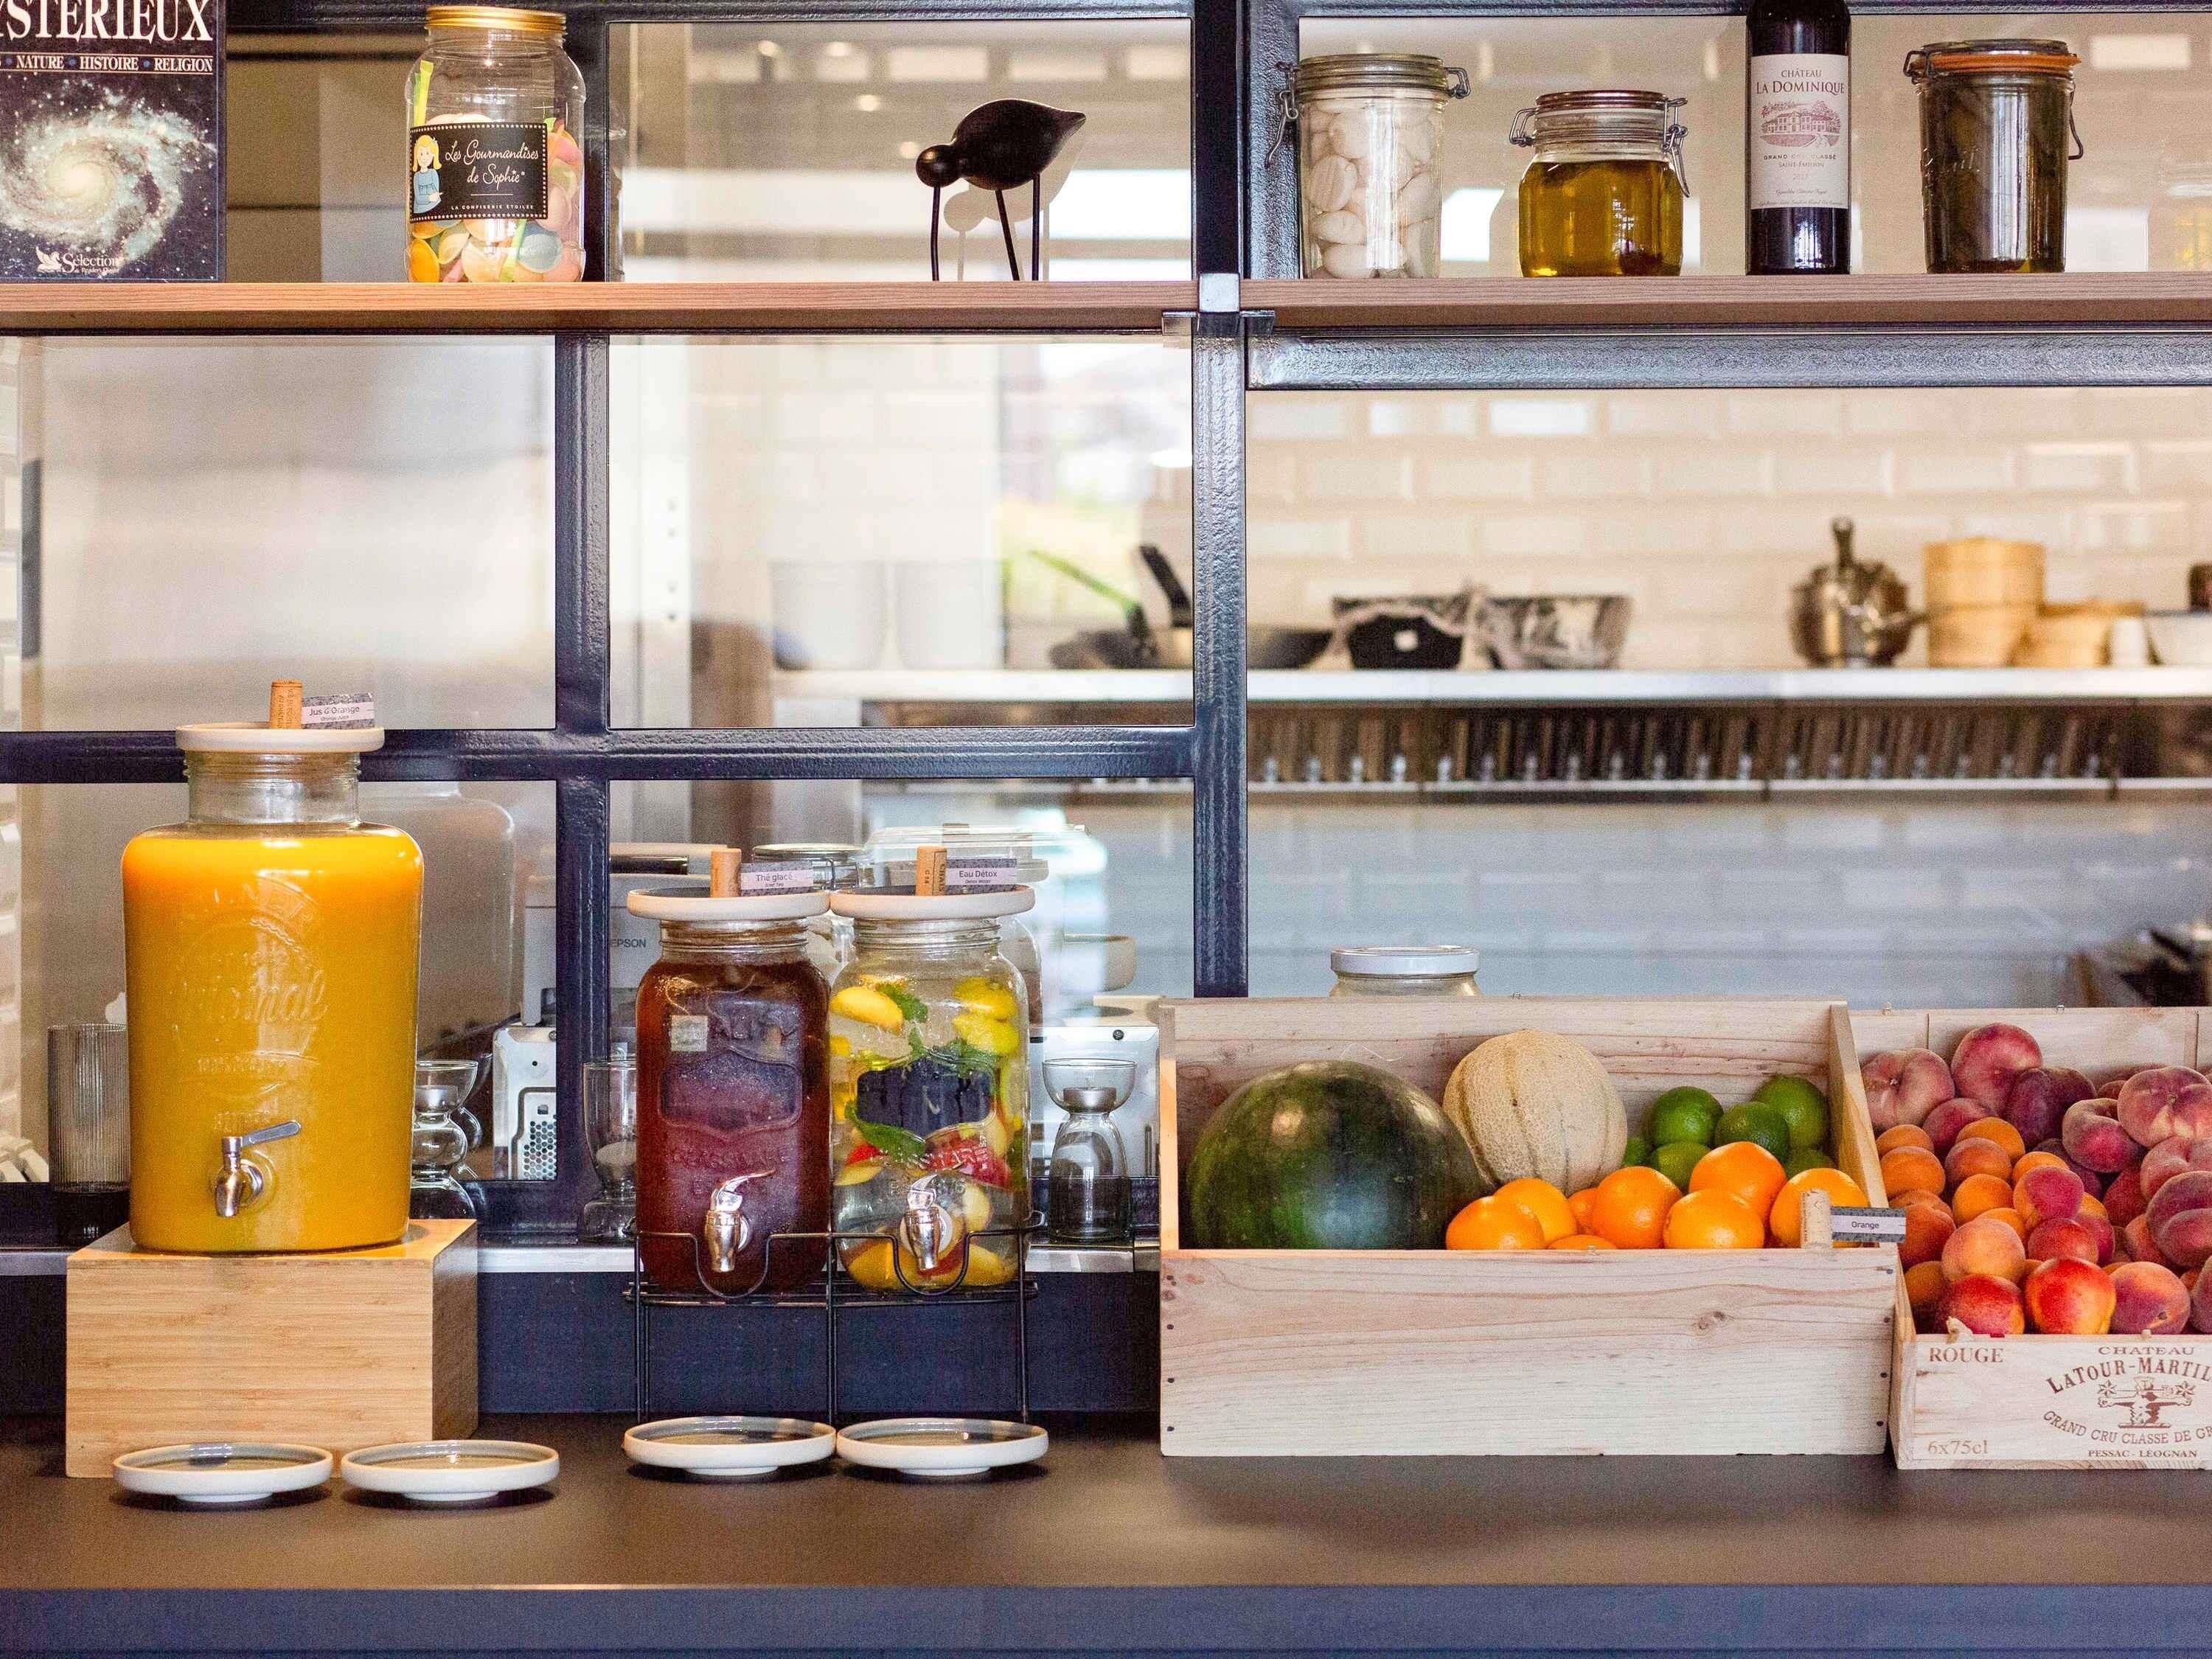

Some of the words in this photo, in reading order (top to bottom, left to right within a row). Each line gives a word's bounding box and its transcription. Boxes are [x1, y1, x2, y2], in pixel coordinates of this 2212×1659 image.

[0, 0, 213, 44] STERIEUX
[16, 55, 64, 69] NATURE
[80, 56, 139, 72] HISTOIRE
[153, 58, 213, 72] RELIGION
[1781, 68, 1821, 78] CHÂTEAU
[1756, 82, 1769, 94] LA
[1772, 80, 1845, 96] DOMINIQUE
[445, 141, 462, 162] Les
[463, 139, 539, 165] Gourmandises
[467, 166, 479, 184] de
[309, 707, 323, 716] Jus
[756, 873, 771, 882] Thé
[611, 938, 647, 948] EPSON
[1851, 1221, 1879, 1230] Orange
[1929, 1348, 2004, 1363] ROUGE
[2098, 1346, 2195, 1355] CHATEAU
[2045, 1357, 2212, 1394] LATOUR-MARTIL
[2042, 1410, 2087, 1437] GRAND
[2090, 1429, 2118, 1443] CRU
[2121, 1433, 2169, 1444] CLASSE
[2174, 1430, 2192, 1443] DE
[1927, 1439, 1989, 1455] 6x75cl
[2087, 1450, 2130, 1458] PESSAC
[2139, 1450, 2198, 1458] LEOGNAN
